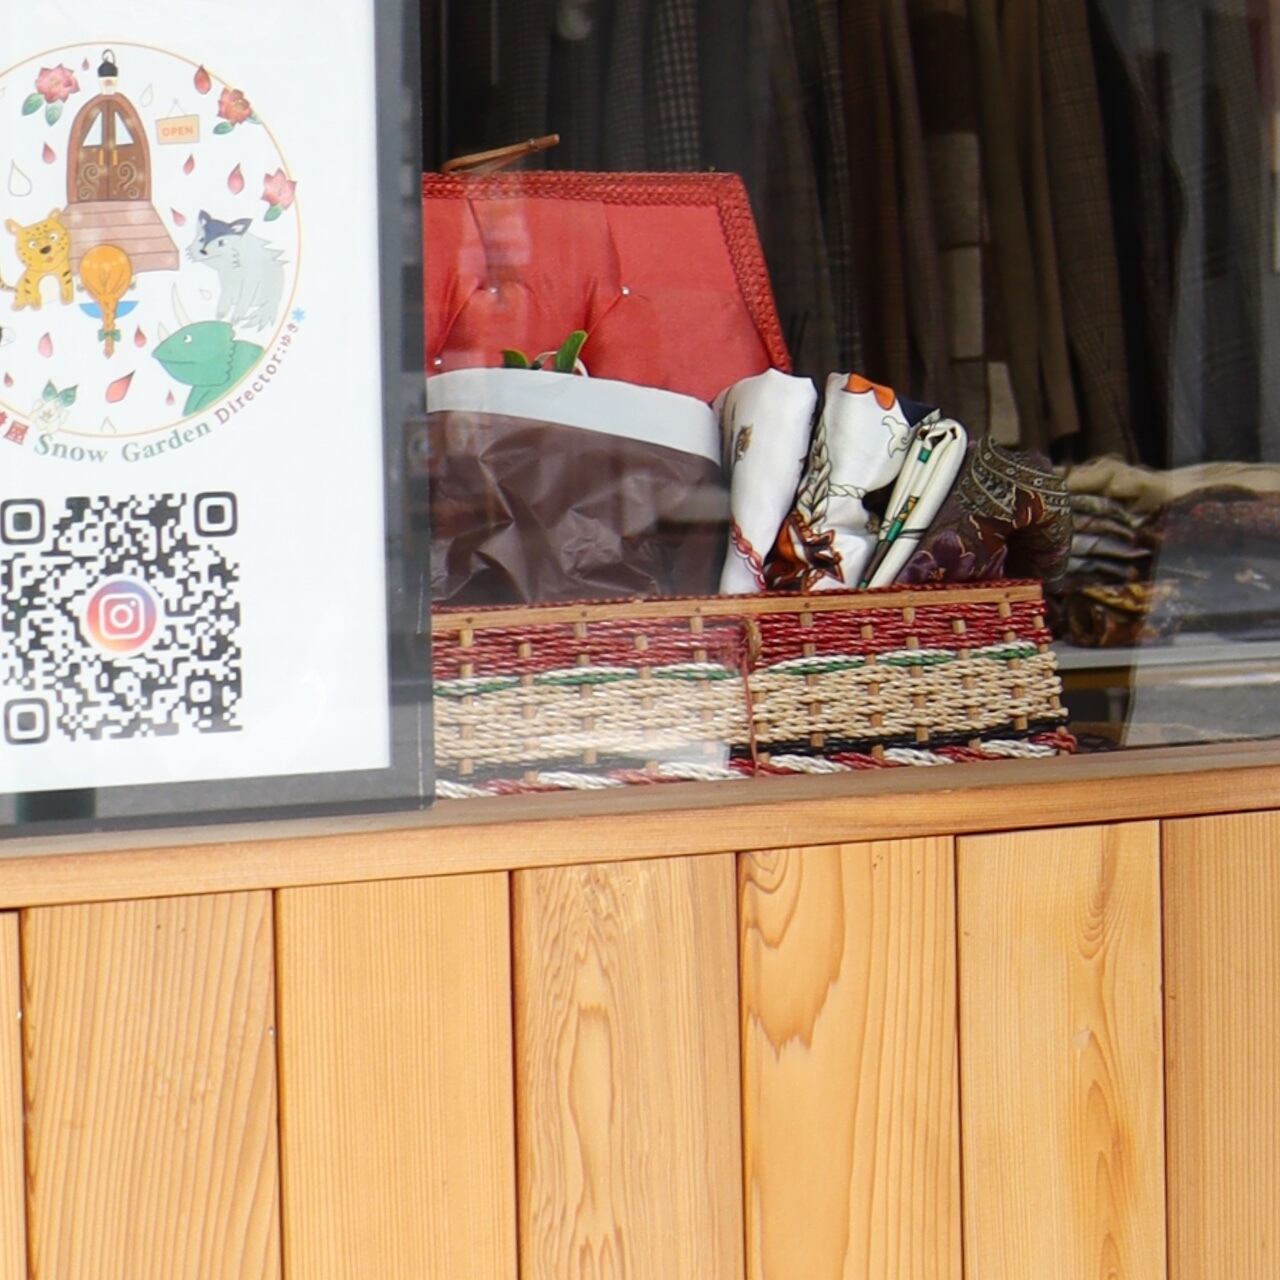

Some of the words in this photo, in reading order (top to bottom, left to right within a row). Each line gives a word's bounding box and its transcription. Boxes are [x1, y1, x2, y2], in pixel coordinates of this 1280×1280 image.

[161, 125, 193, 137] OPEN
[33, 433, 108, 463] Snow
[121, 421, 214, 463] Garden
